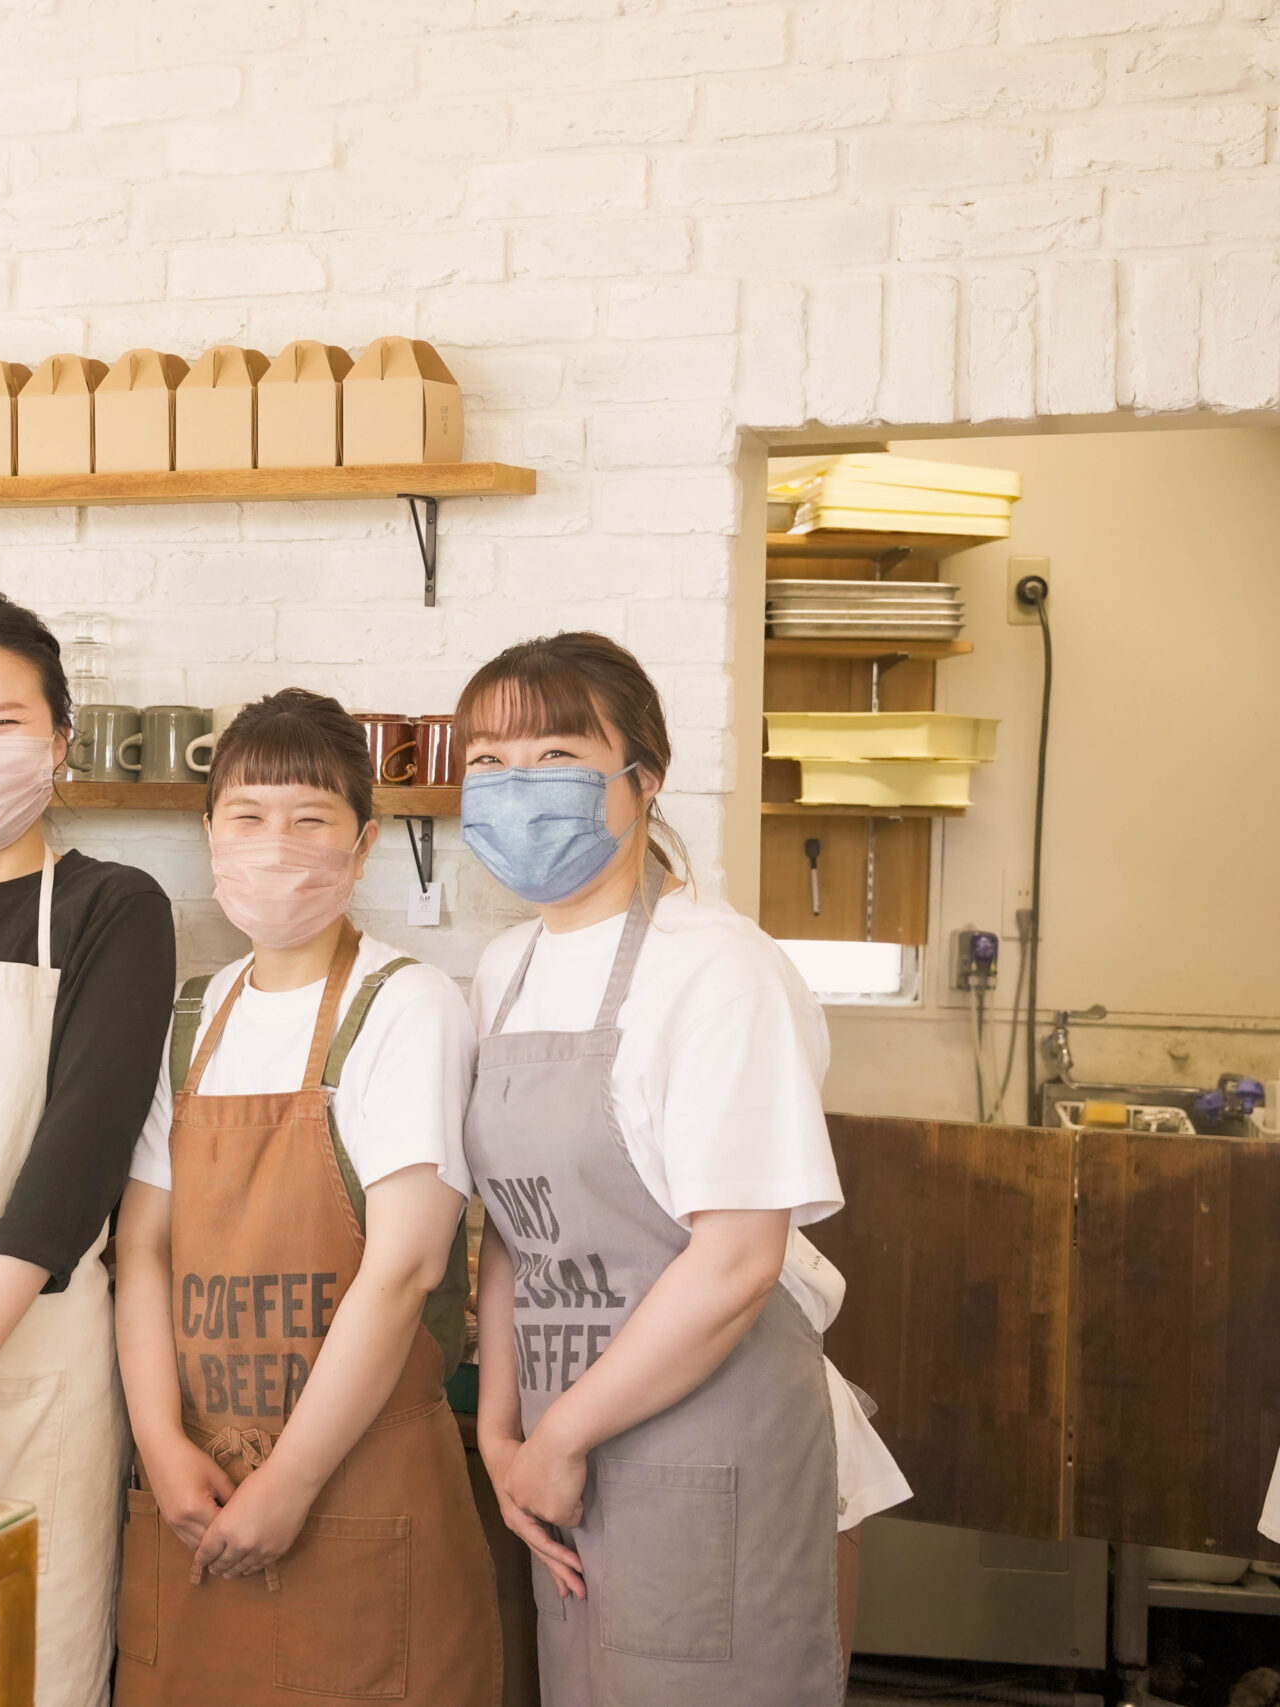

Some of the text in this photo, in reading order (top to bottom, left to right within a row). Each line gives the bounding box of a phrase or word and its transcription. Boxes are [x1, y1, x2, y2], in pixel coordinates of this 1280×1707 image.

[487, 1176, 560, 1245] DAYS
[181, 1272, 337, 1340] COFFEE
[199, 1352, 309, 1417] BEER
[514, 1324, 611, 1393] FFEE
